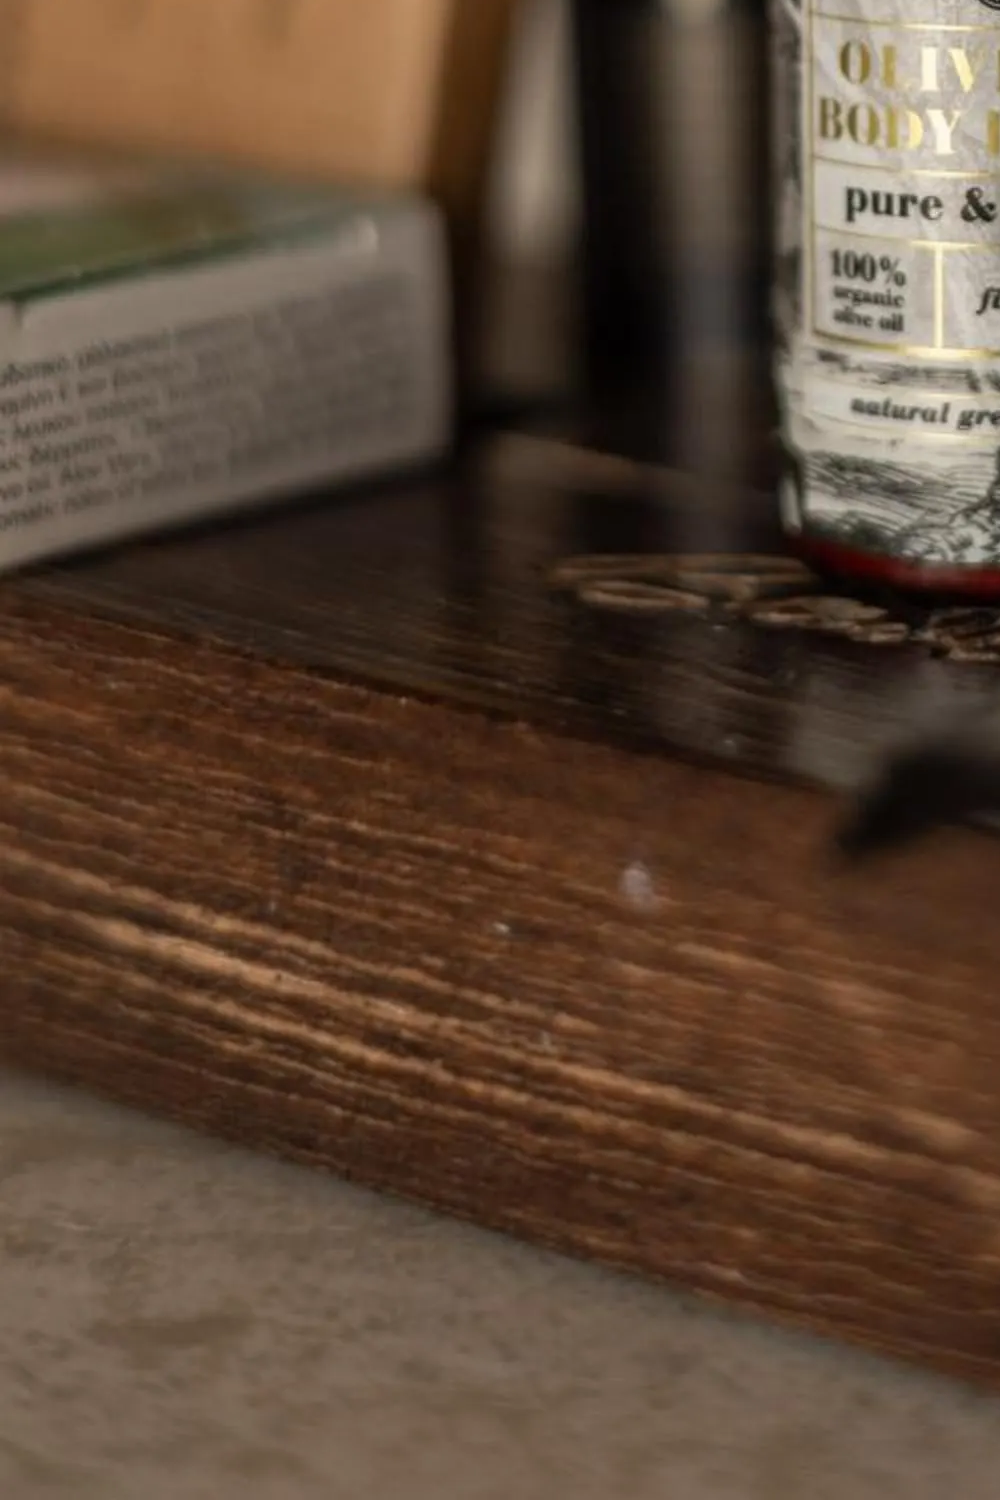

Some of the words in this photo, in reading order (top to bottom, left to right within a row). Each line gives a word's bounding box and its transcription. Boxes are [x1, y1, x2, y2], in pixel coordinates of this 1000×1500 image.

[819, 97, 962, 155] BODY
[844, 185, 943, 223] pure
[960, 187, 997, 222] &
[830, 249, 907, 287] 100%
[850, 395, 950, 424] natural
